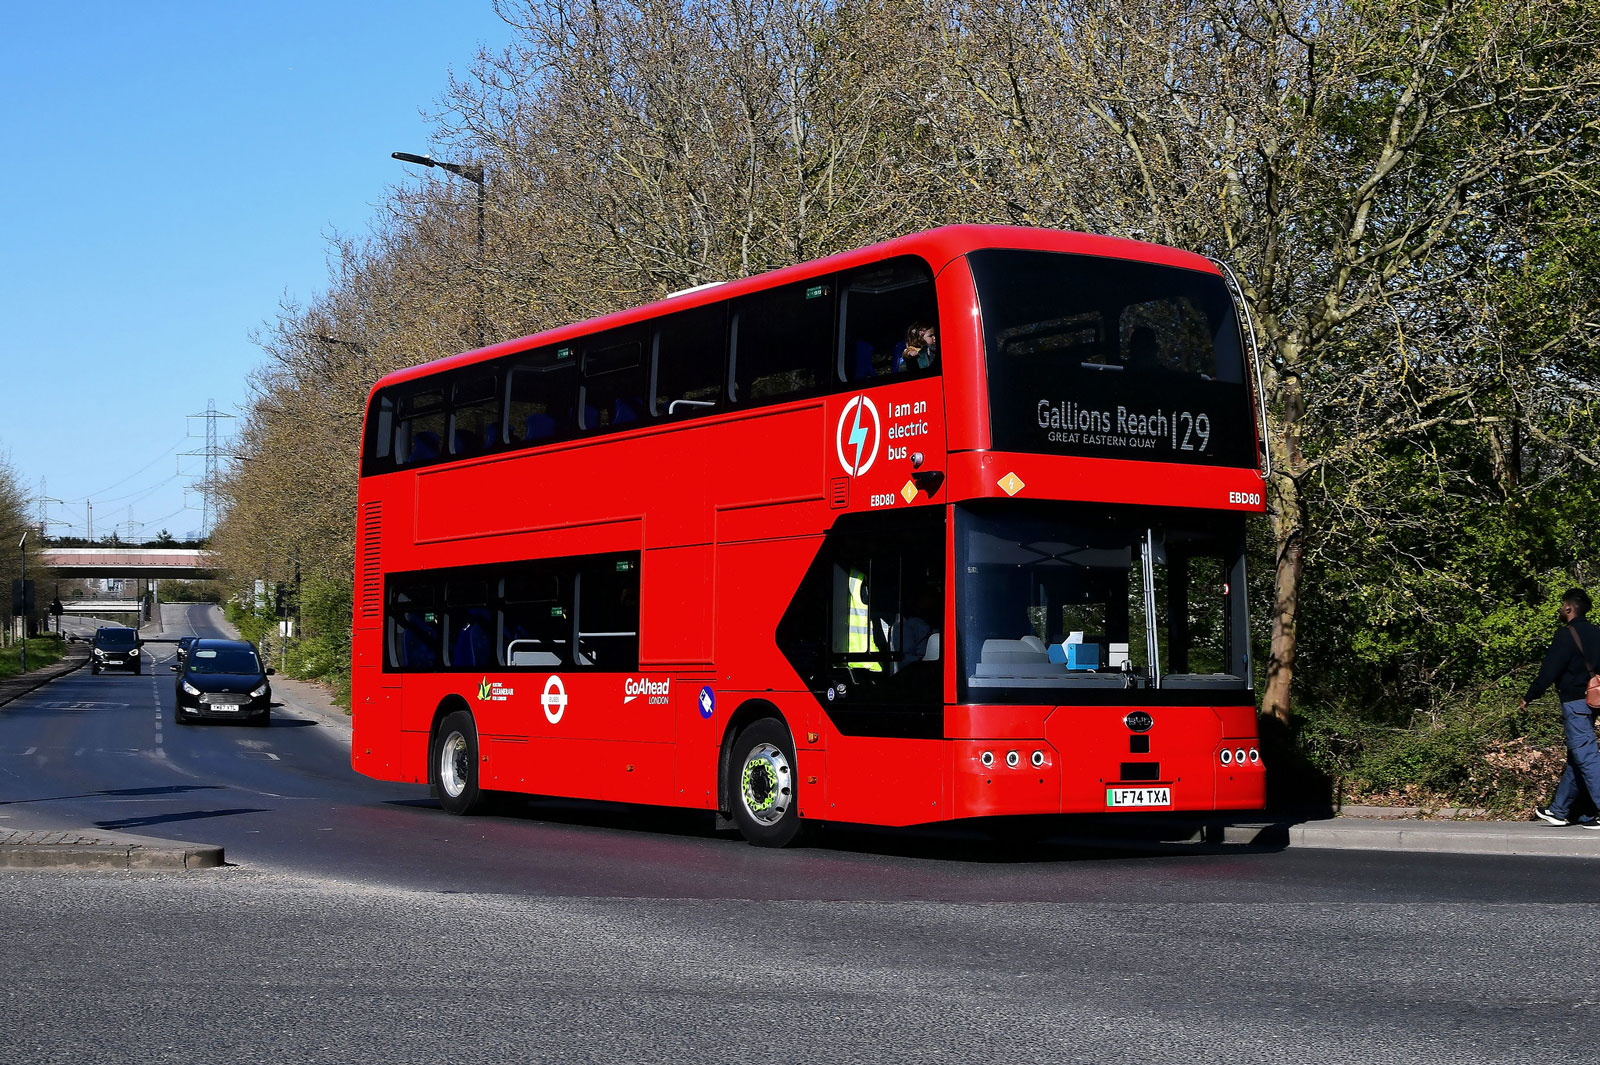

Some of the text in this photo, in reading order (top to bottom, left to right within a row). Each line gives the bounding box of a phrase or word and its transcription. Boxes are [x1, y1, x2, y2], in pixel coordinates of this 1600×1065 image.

[888, 400, 927, 418] I am an
[1037, 399, 1168, 437] Gallions Reach
[888, 419, 928, 439] electric
[1171, 411, 1210, 452] 129
[1047, 431, 1157, 449] GREAT EASTERN QUAY
[888, 445, 907, 461] bus
[870, 493, 895, 507] EBD80
[1229, 491, 1260, 505] EBD80
[624, 677, 670, 695] GoAhead
[648, 696, 669, 705] LONDON
[1114, 790, 1168, 804] LF74 TXA
